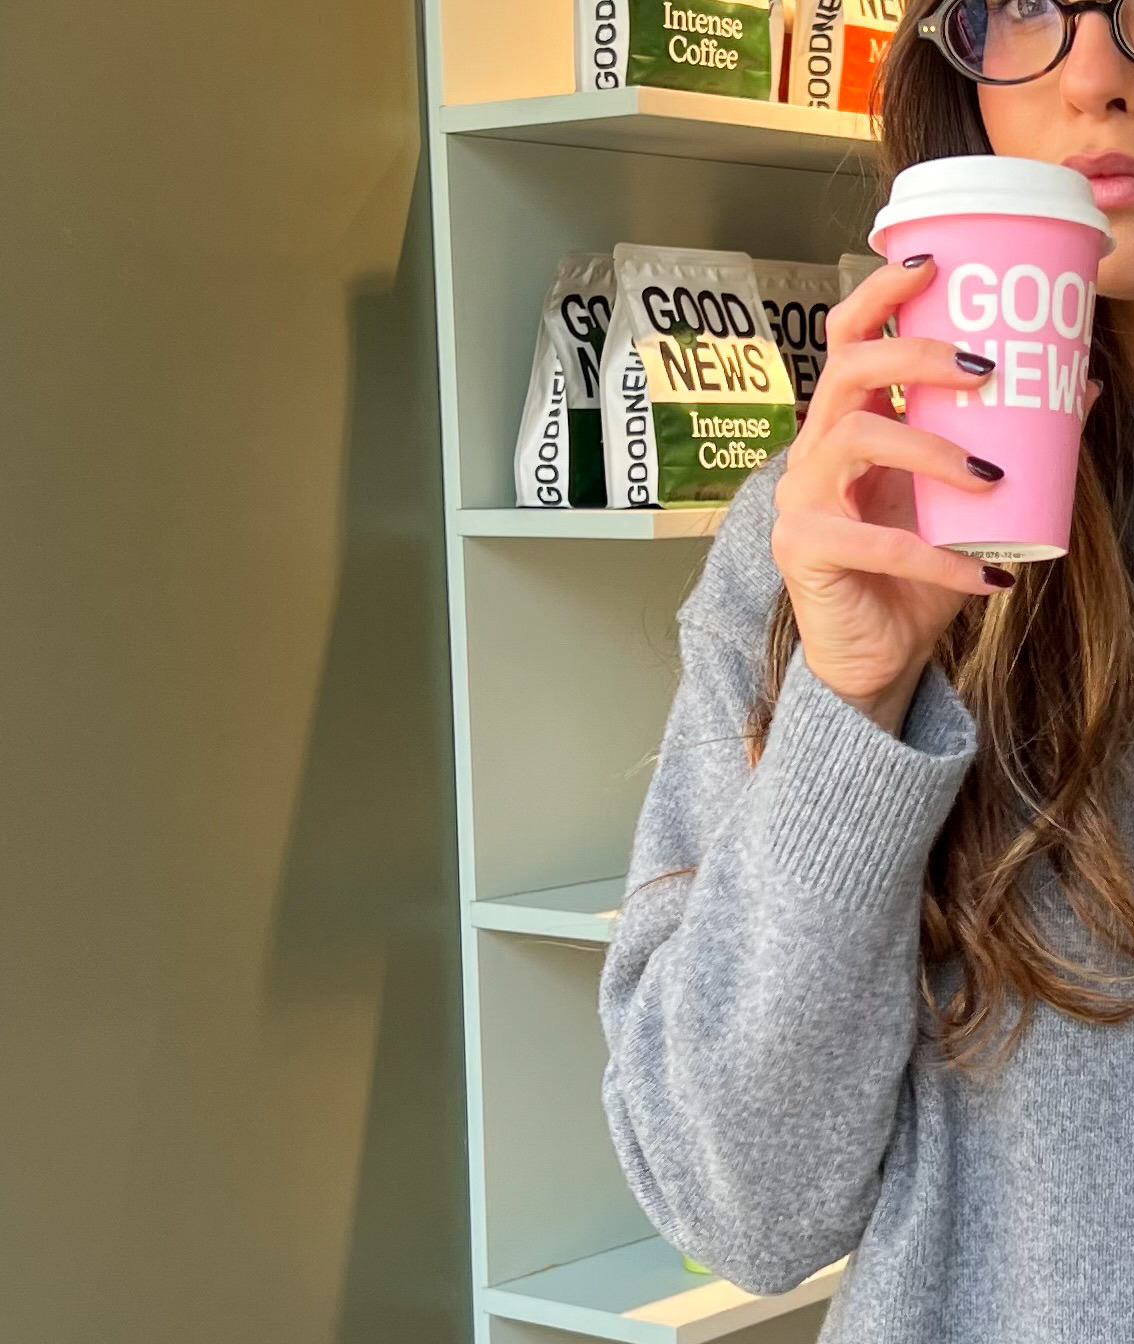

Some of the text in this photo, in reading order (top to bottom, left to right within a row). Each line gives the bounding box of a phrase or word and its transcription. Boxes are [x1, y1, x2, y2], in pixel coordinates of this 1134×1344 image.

[663, 2, 743, 40] Intense
[669, 35, 739, 70] Coffee
[641, 286, 756, 339] GOOD
[762, 300, 829, 352] GOO
[659, 338, 770, 393] NEWS
[689, 411, 771, 439] Intense
[699, 441, 767, 470] Coffee
